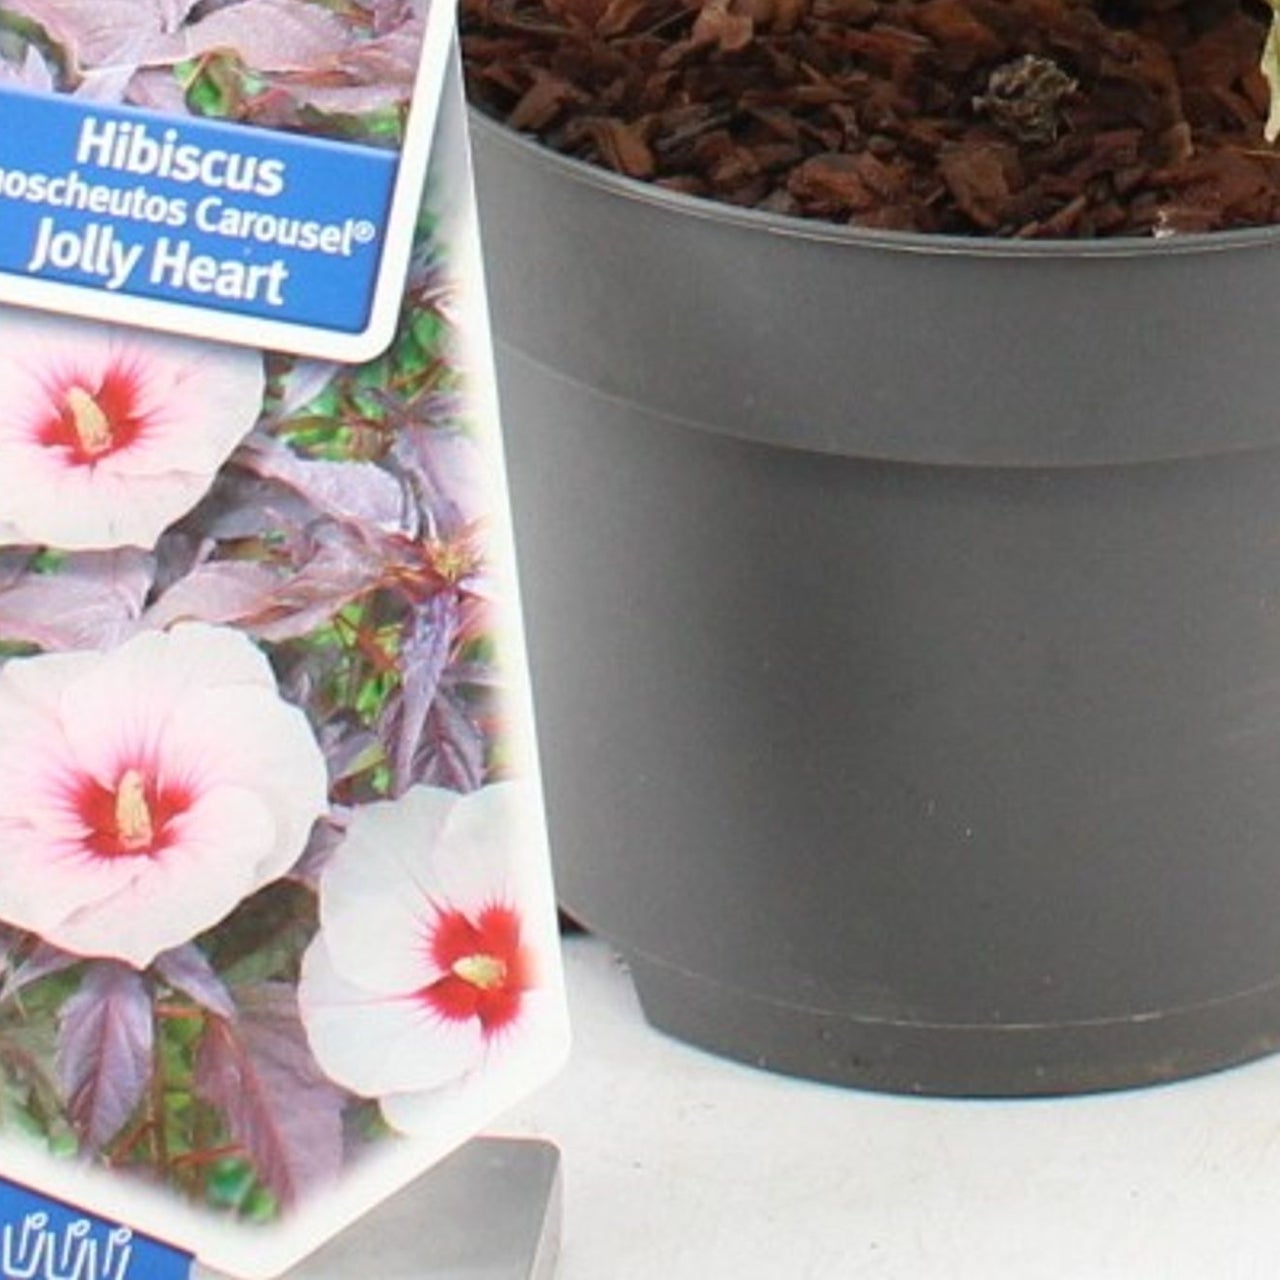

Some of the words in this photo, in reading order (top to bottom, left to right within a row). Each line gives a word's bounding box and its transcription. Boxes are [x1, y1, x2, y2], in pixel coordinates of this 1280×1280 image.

[75, 117, 286, 197] Hibiscus
[27, 217, 144, 290] Jolly
[149, 237, 290, 307] Heart
